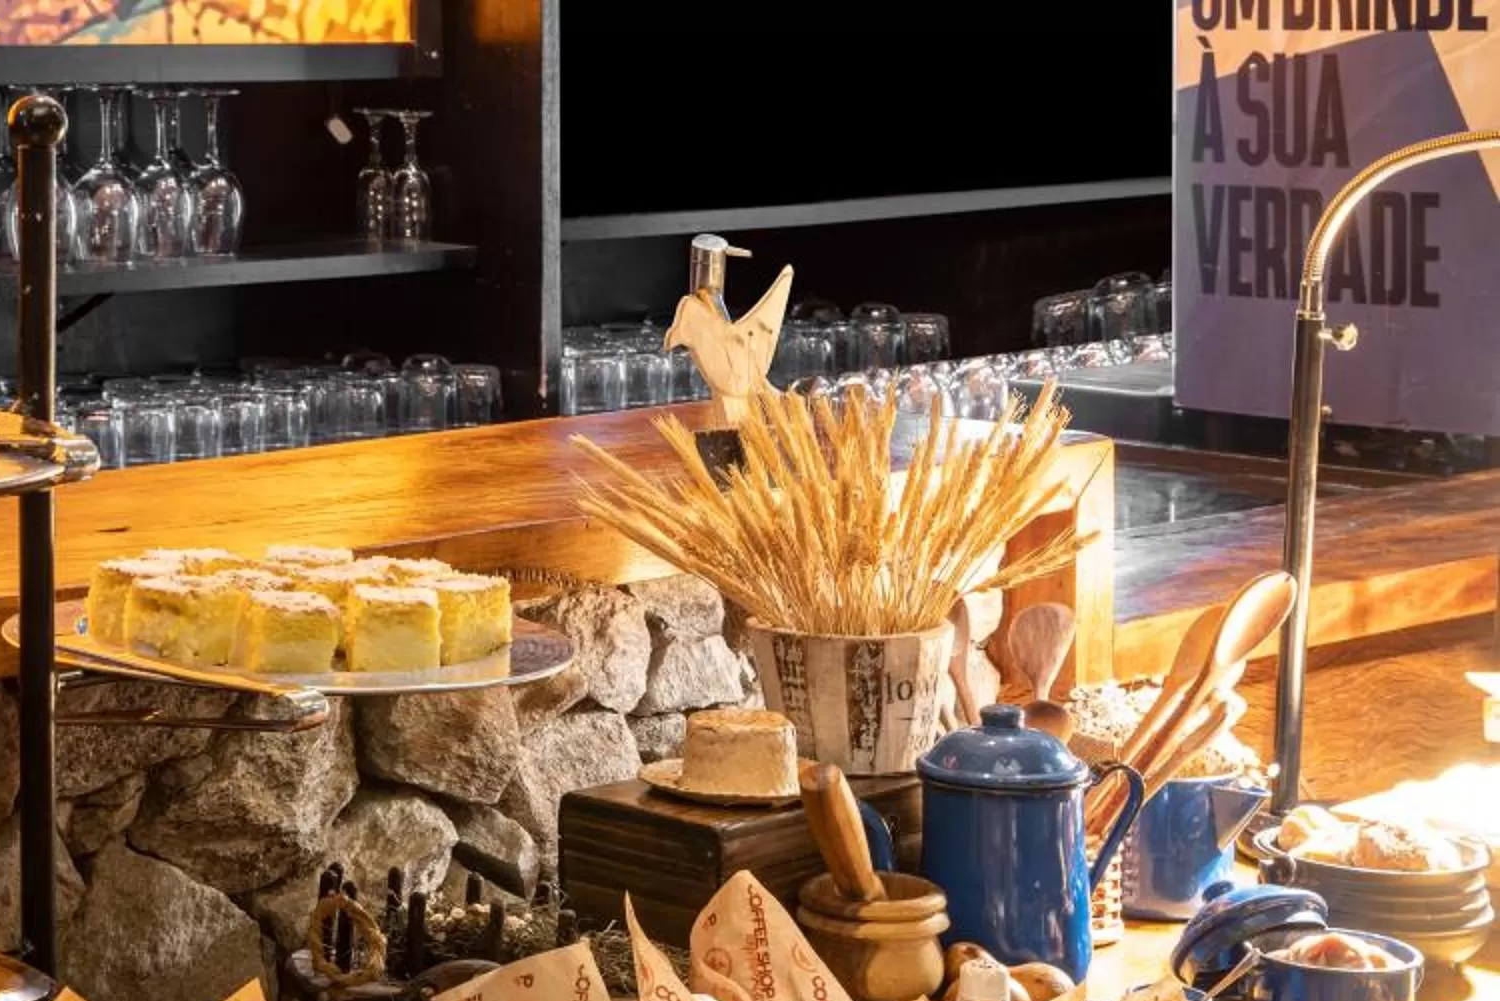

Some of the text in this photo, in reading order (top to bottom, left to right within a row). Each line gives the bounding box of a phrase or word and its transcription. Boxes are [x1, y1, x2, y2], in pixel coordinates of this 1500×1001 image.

[1192, 36, 1350, 168] À SUA
[757, 952, 775, 1000] SHOP
